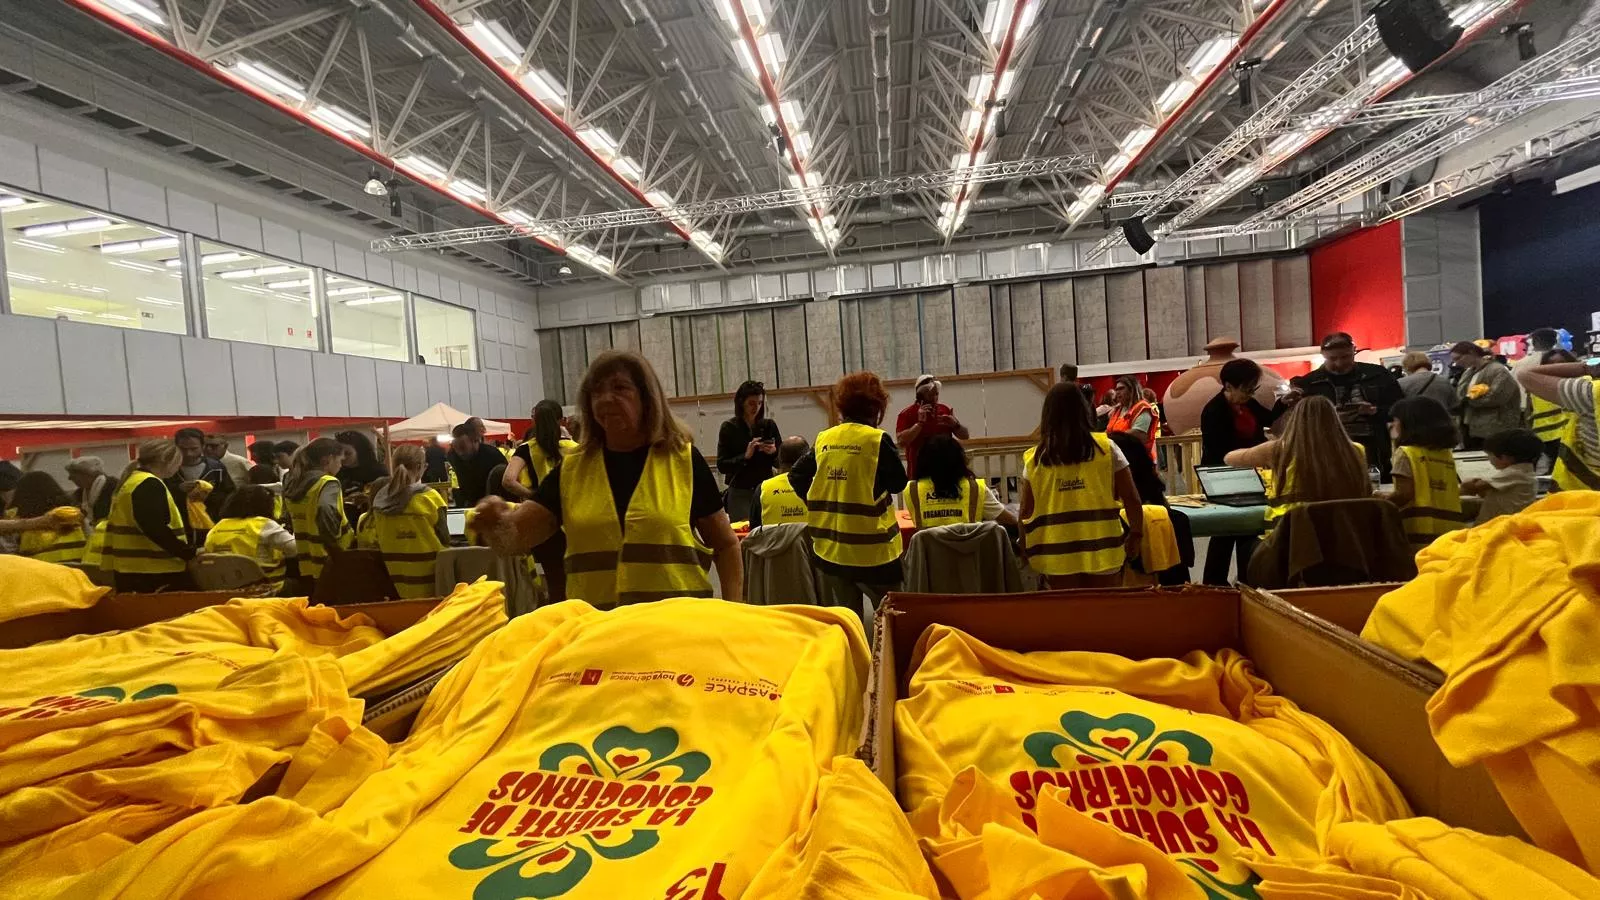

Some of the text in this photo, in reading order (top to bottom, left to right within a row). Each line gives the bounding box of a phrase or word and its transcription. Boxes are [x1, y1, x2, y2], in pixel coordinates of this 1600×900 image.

[704, 683, 768, 697] ASPACE
[488, 771, 714, 809] CONOCERNOS
[458, 801, 697, 838] LA SUERTE DE
[1213, 807, 1277, 857] LA
